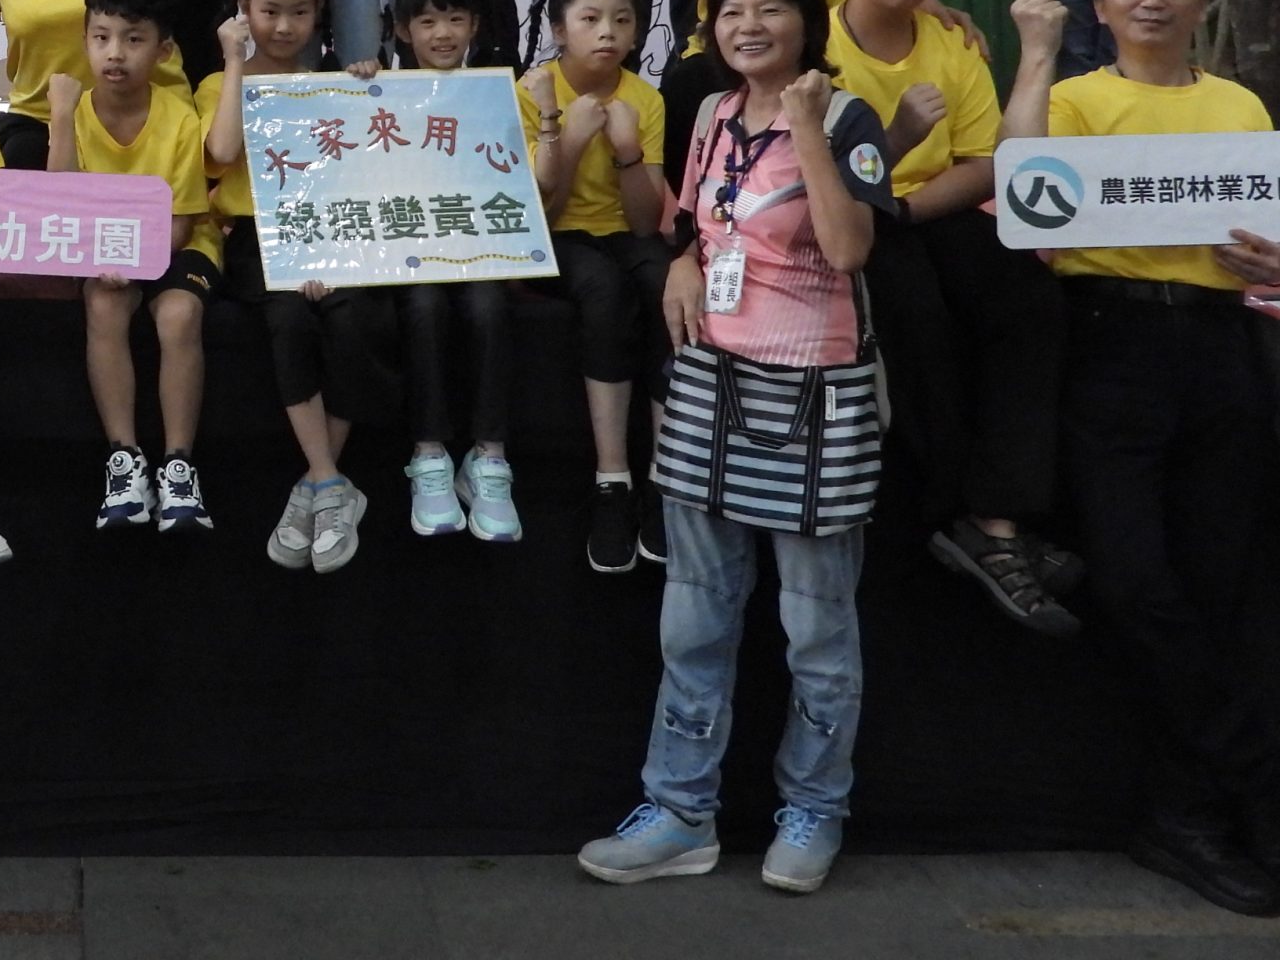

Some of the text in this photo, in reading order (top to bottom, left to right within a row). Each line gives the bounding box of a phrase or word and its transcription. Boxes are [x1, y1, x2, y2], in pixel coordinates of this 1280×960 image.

[265, 107, 519, 190] 大家來用心
[1100, 174, 1280, 205] 農業部林業及
